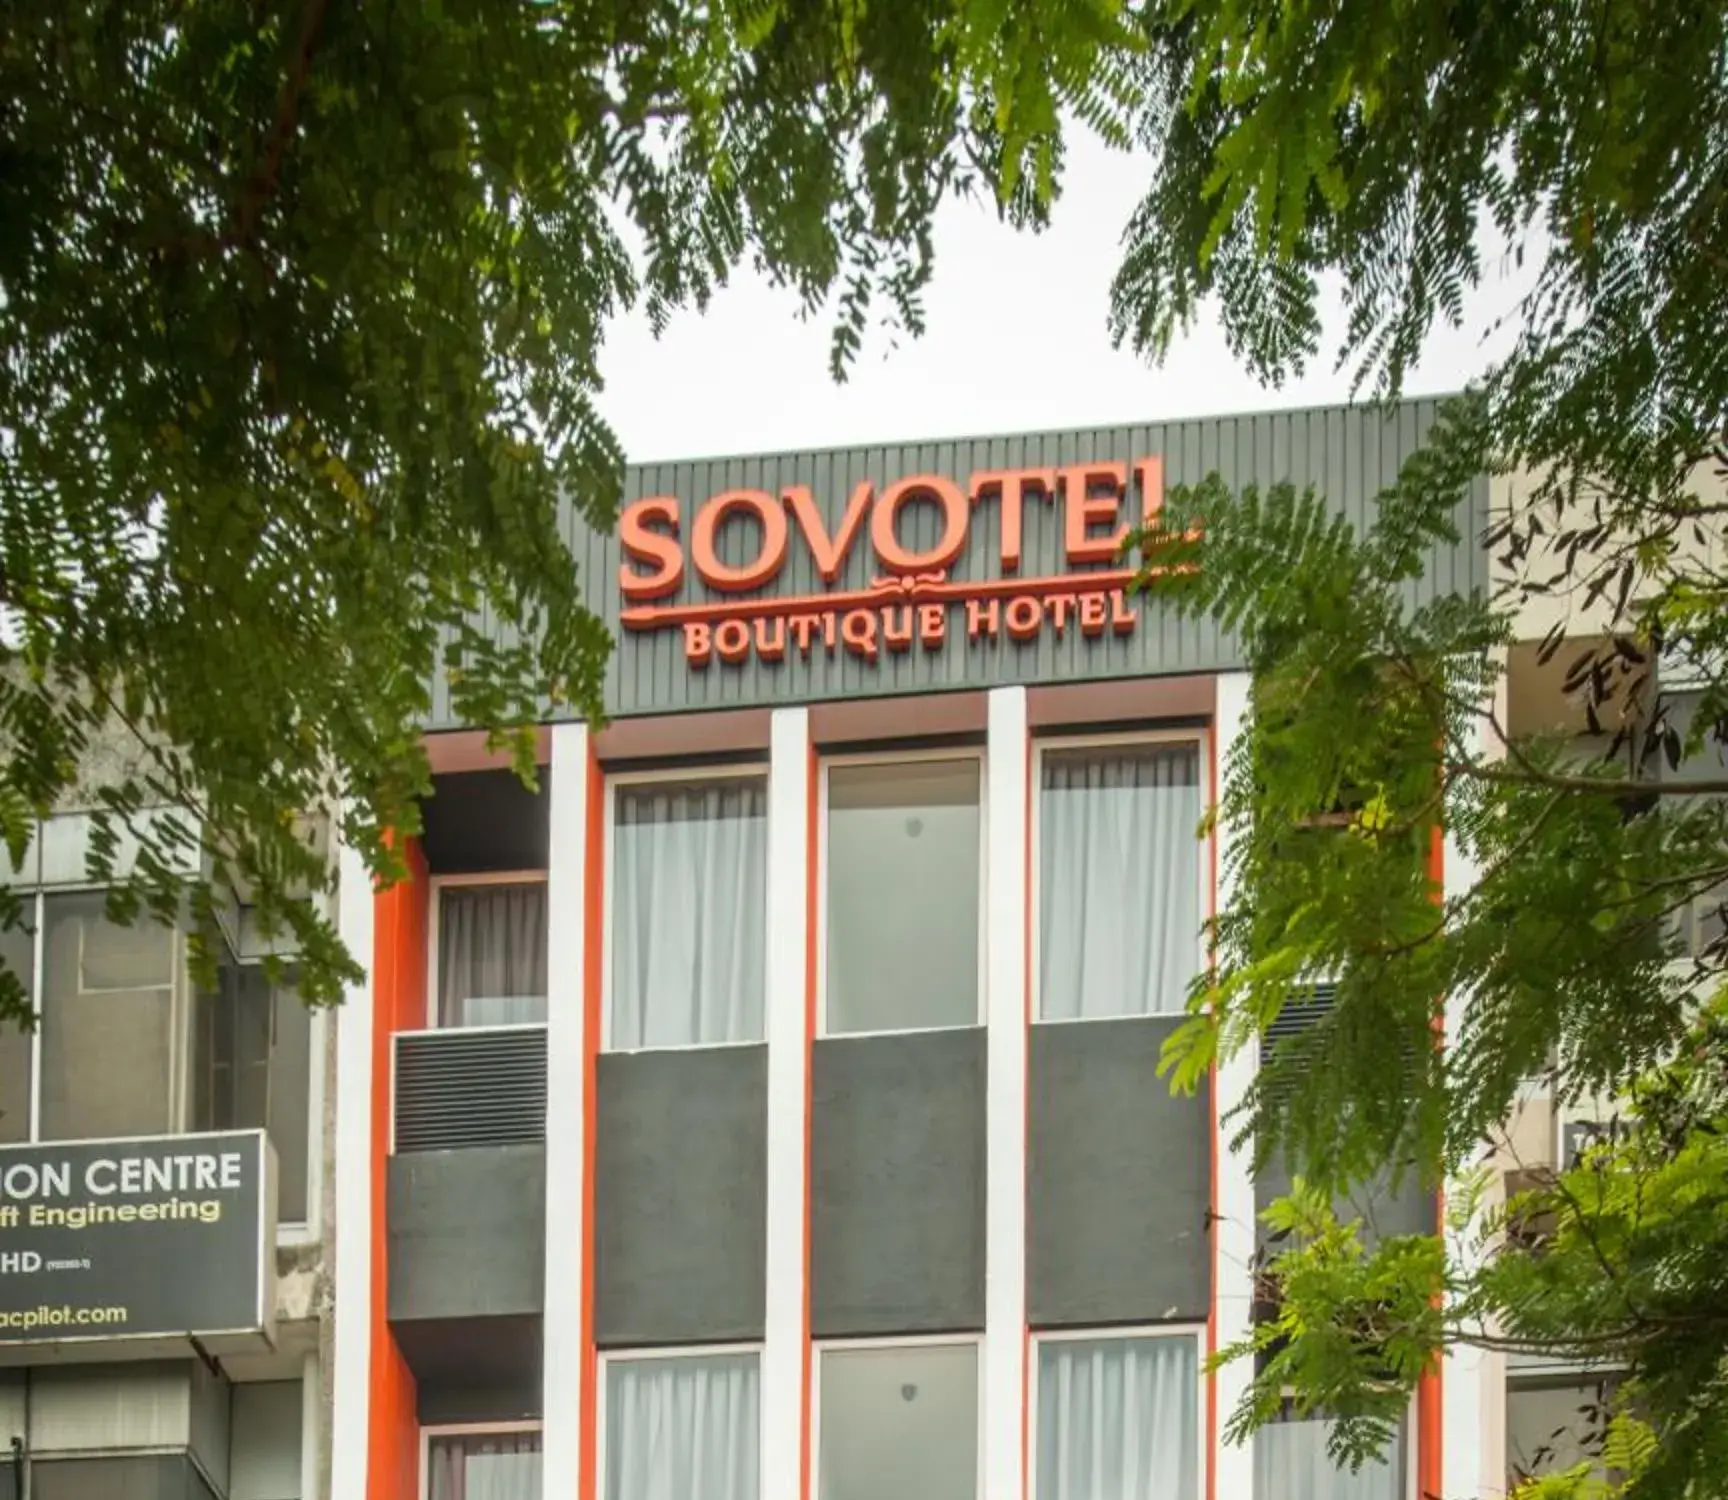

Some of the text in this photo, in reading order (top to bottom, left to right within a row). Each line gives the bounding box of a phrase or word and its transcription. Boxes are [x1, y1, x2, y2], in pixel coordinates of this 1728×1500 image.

[619, 456, 1205, 598] SOVOTEL
[683, 589, 1138, 669] BOUTIQUE HOTEL
[0, 1153, 241, 1199] ON CENTRE
[30, 1198, 221, 1228] Engineering
[0, 1305, 127, 1330] acpilot.com
